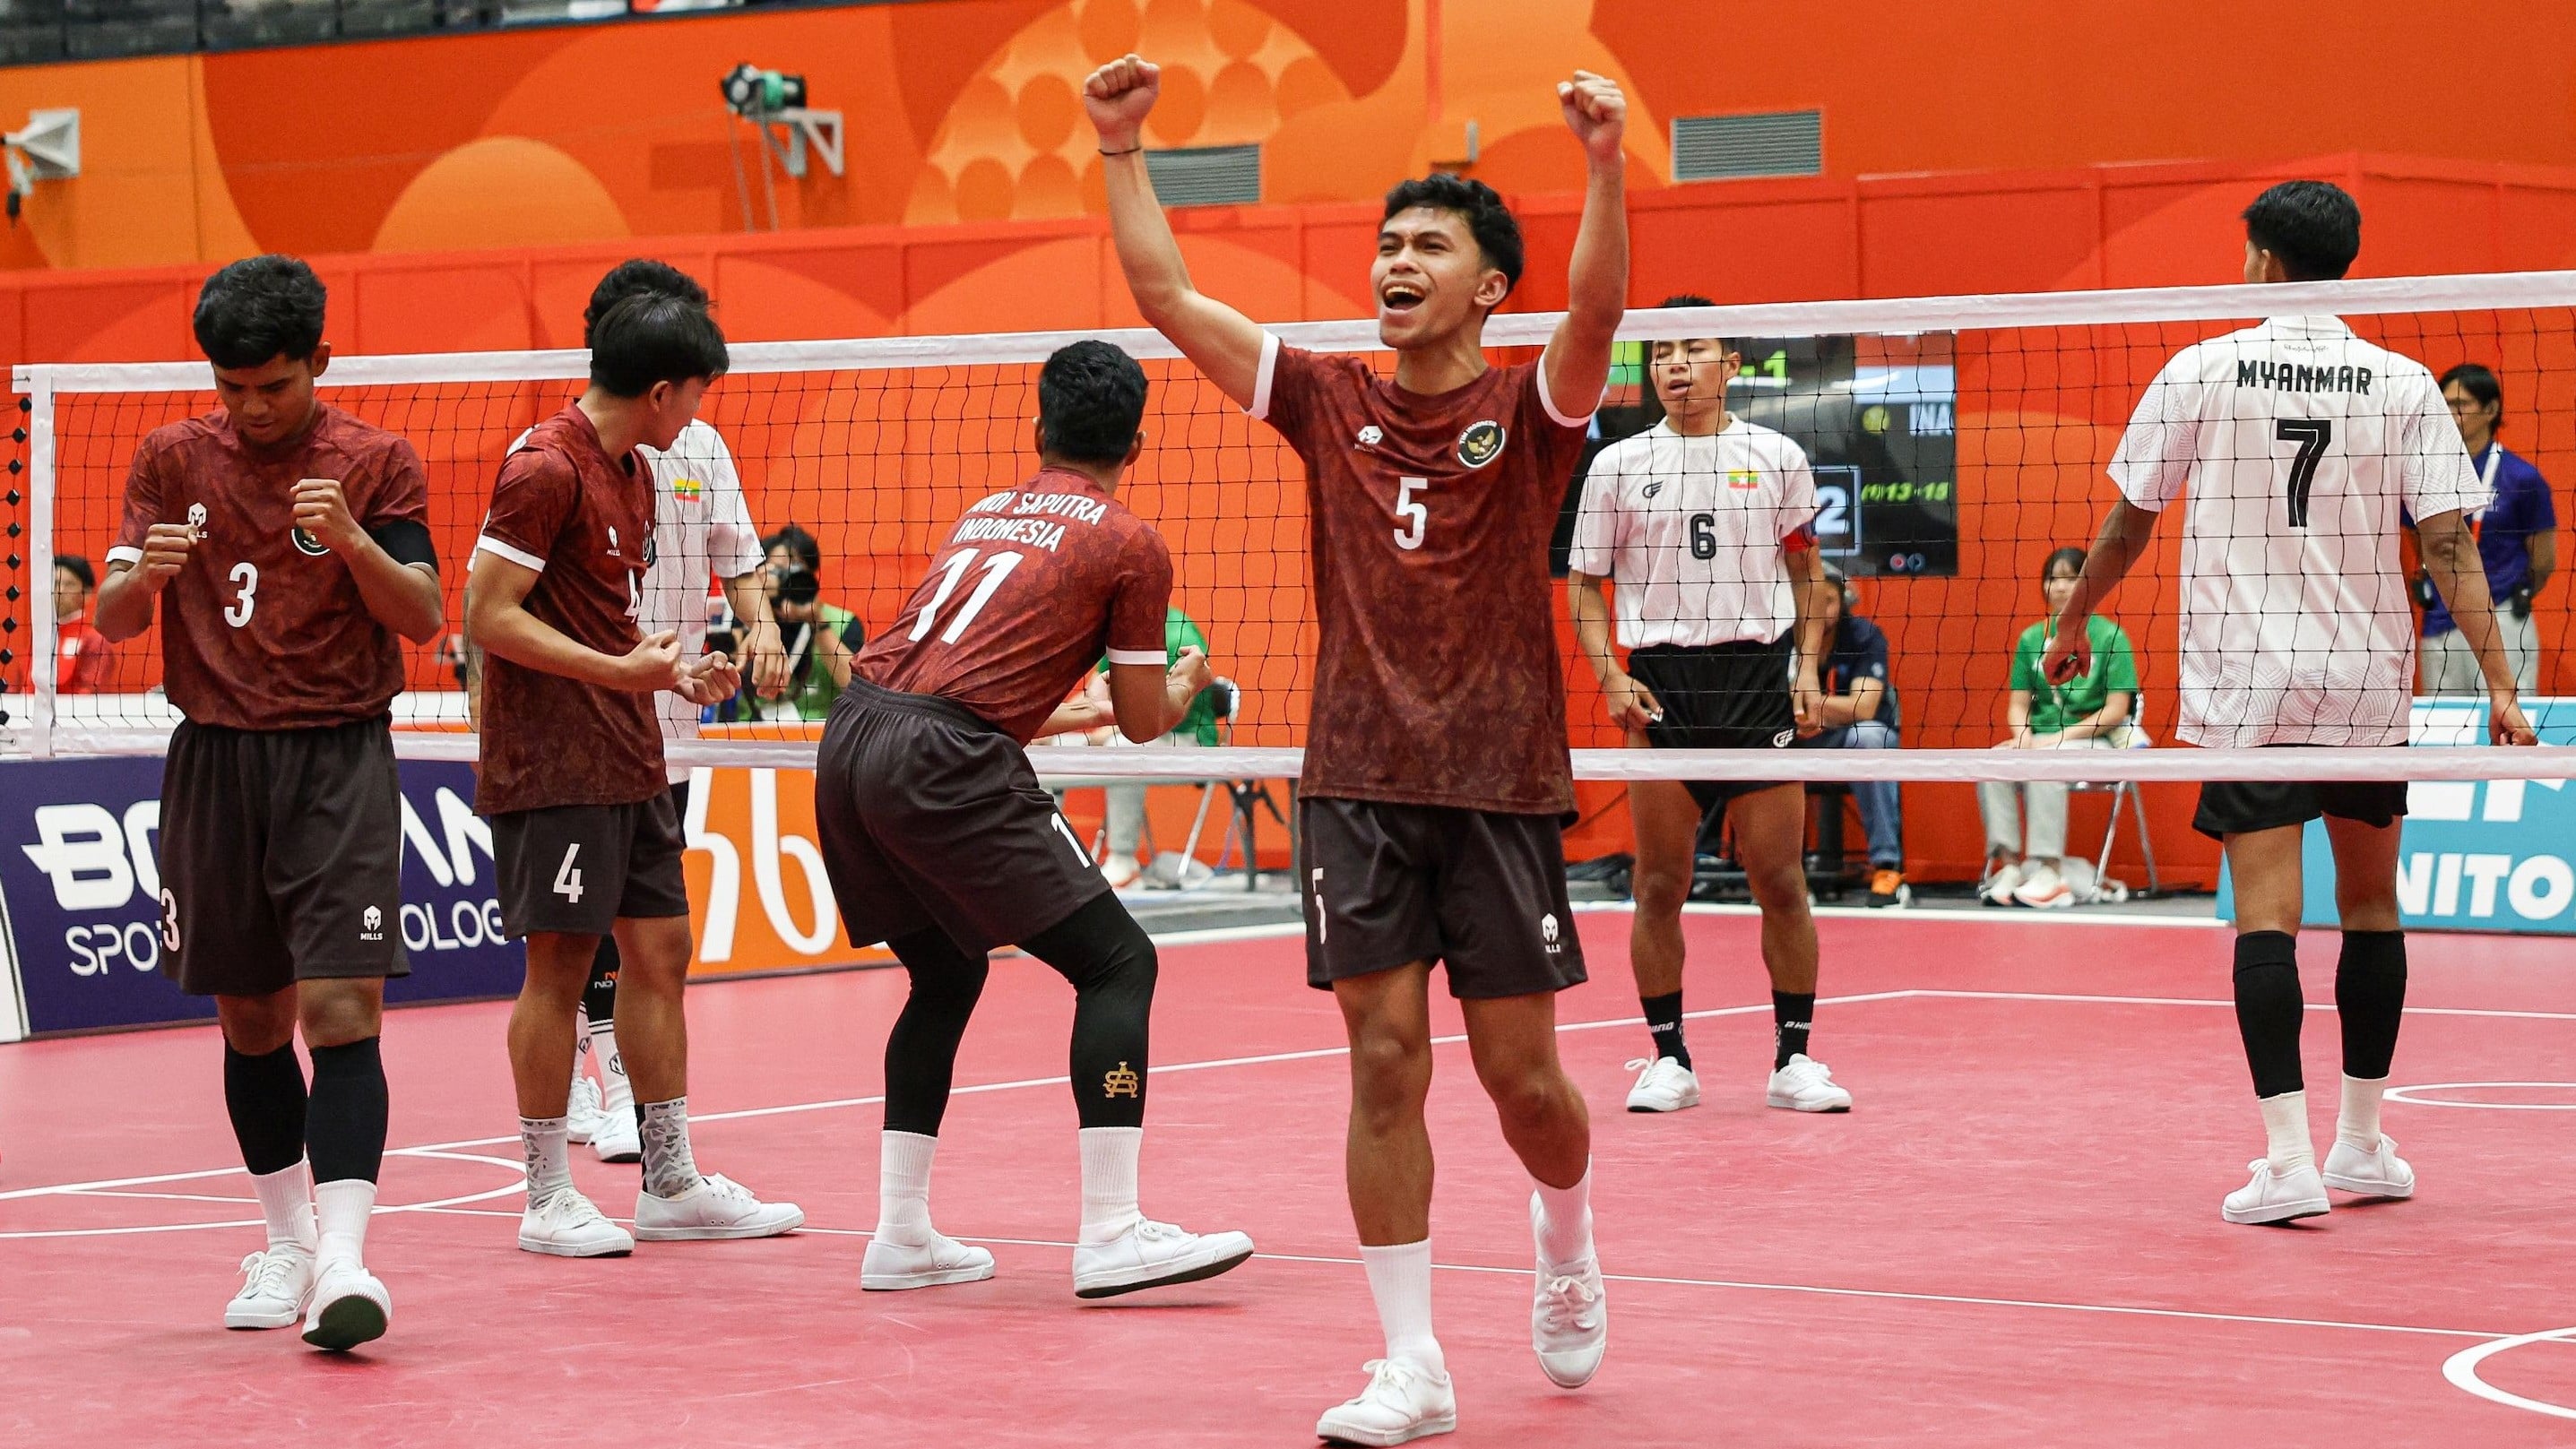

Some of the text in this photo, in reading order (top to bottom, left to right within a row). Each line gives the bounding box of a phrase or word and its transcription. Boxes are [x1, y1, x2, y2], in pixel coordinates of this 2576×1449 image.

[2237, 359, 2372, 395] MYANMAR
[1909, 403, 1953, 436] INA
[2277, 418, 2331, 527] 7
[952, 517, 1066, 553] INDONESIA
[1013, 493, 1107, 526] SAPUTRA
[1394, 477, 1428, 549] 5
[1815, 485, 1850, 535] 2
[1690, 513, 1716, 560] 6
[224, 562, 258, 627] 3
[907, 548, 1024, 645] 11
[553, 843, 583, 903] 4
[160, 887, 180, 953] 3
[360, 932, 383, 941] MILLS
[65, 919, 162, 976] SPO
